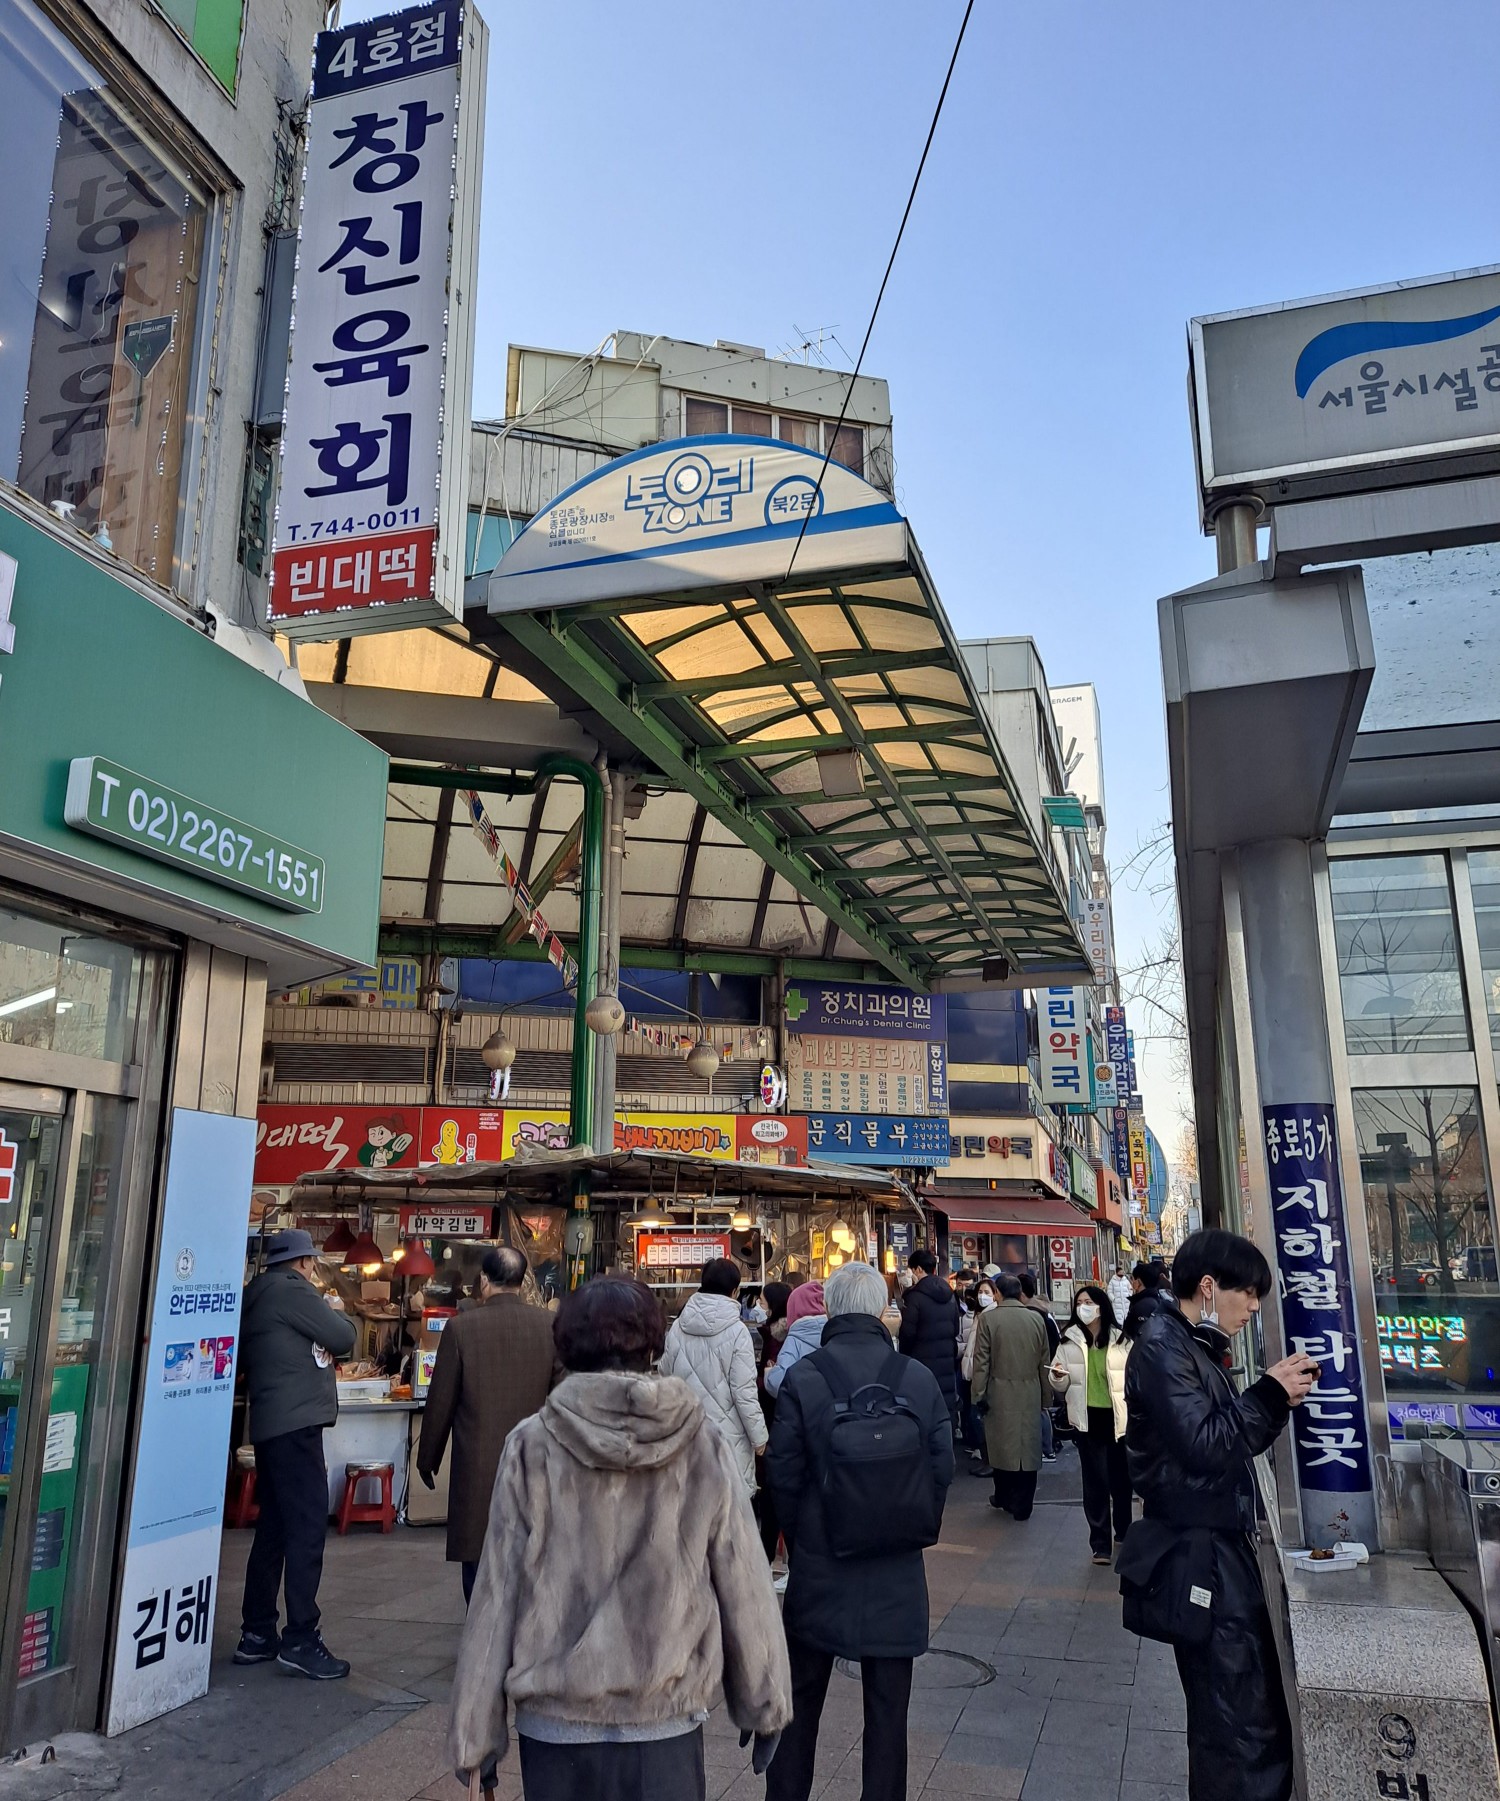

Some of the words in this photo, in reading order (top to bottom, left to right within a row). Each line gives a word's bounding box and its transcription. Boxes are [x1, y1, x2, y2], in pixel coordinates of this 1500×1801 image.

[327, 11, 446, 79] 4호점
[303, 100, 445, 507] 창신육회
[287, 507, 420, 542] T.744-0011
[643, 494, 733, 534] ZONE
[772, 491, 816, 514] 북2문
[289, 543, 418, 603] 빈대떡
[96, 770, 121, 818] T
[127, 787, 320, 902] 02)2267-1551
[820, 990, 932, 1019] 정치과의원
[820, 1016, 870, 1027] Dr.Chung's
[873, 1019, 903, 1028] Dental
[906, 1021, 931, 1030] Clinic
[805, 1038, 924, 1072] 패션맞춤프라자
[930, 1045, 944, 1100] 동양금박
[1265, 1115, 1333, 1165] 종로5가
[414, 1216, 478, 1232] 마약김밥
[1276, 1178, 1342, 1311] 지하철
[169, 1292, 237, 1316] 안티푸라민
[1289, 1329, 1364, 1470] 타는곳
[132, 1574, 212, 1670] 김해
[1377, 1712, 1417, 1761] 9
